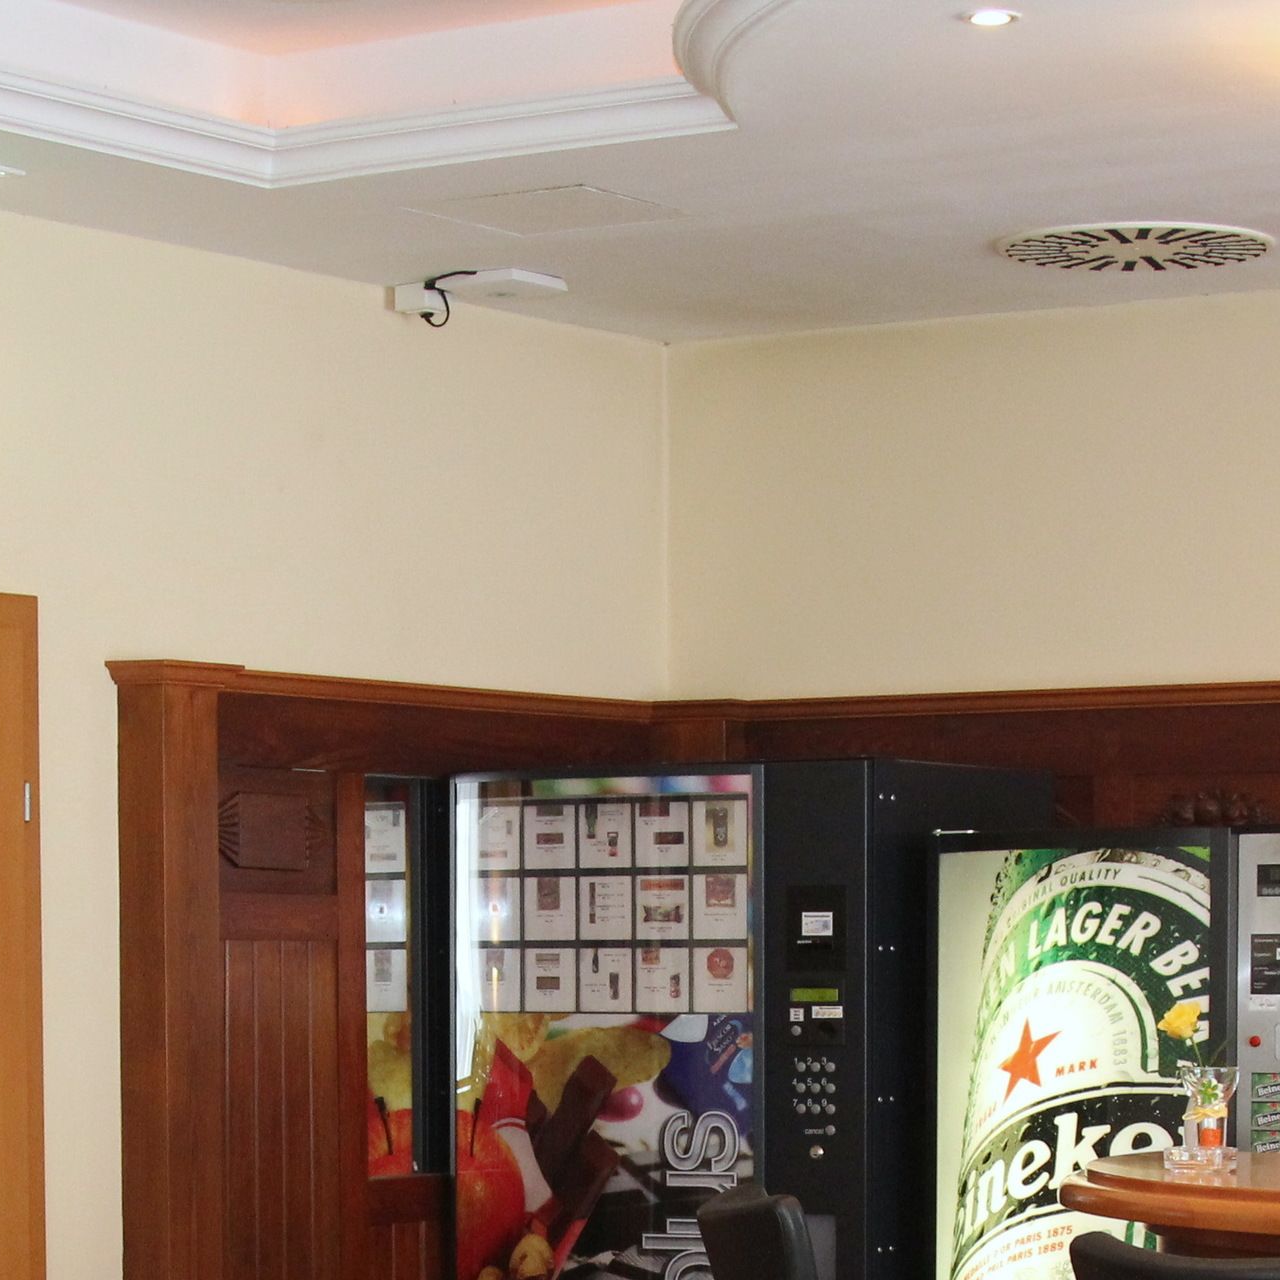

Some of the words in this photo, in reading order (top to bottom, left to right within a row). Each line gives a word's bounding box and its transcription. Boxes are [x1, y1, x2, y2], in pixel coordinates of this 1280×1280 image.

[1060, 868, 1122, 886] QUALITY
[1028, 901, 1162, 960] LAGER
[1046, 978, 1124, 1025] AMSTERDAM
[1112, 1030, 1128, 1067] 1883
[1055, 1058, 1098, 1078] MARK
[1015, 1232, 1042, 1248] PARIS
[1047, 1225, 1073, 1240] 1875
[1007, 1248, 1033, 1263] PARIS
[1038, 1241, 1065, 1256] 1889
